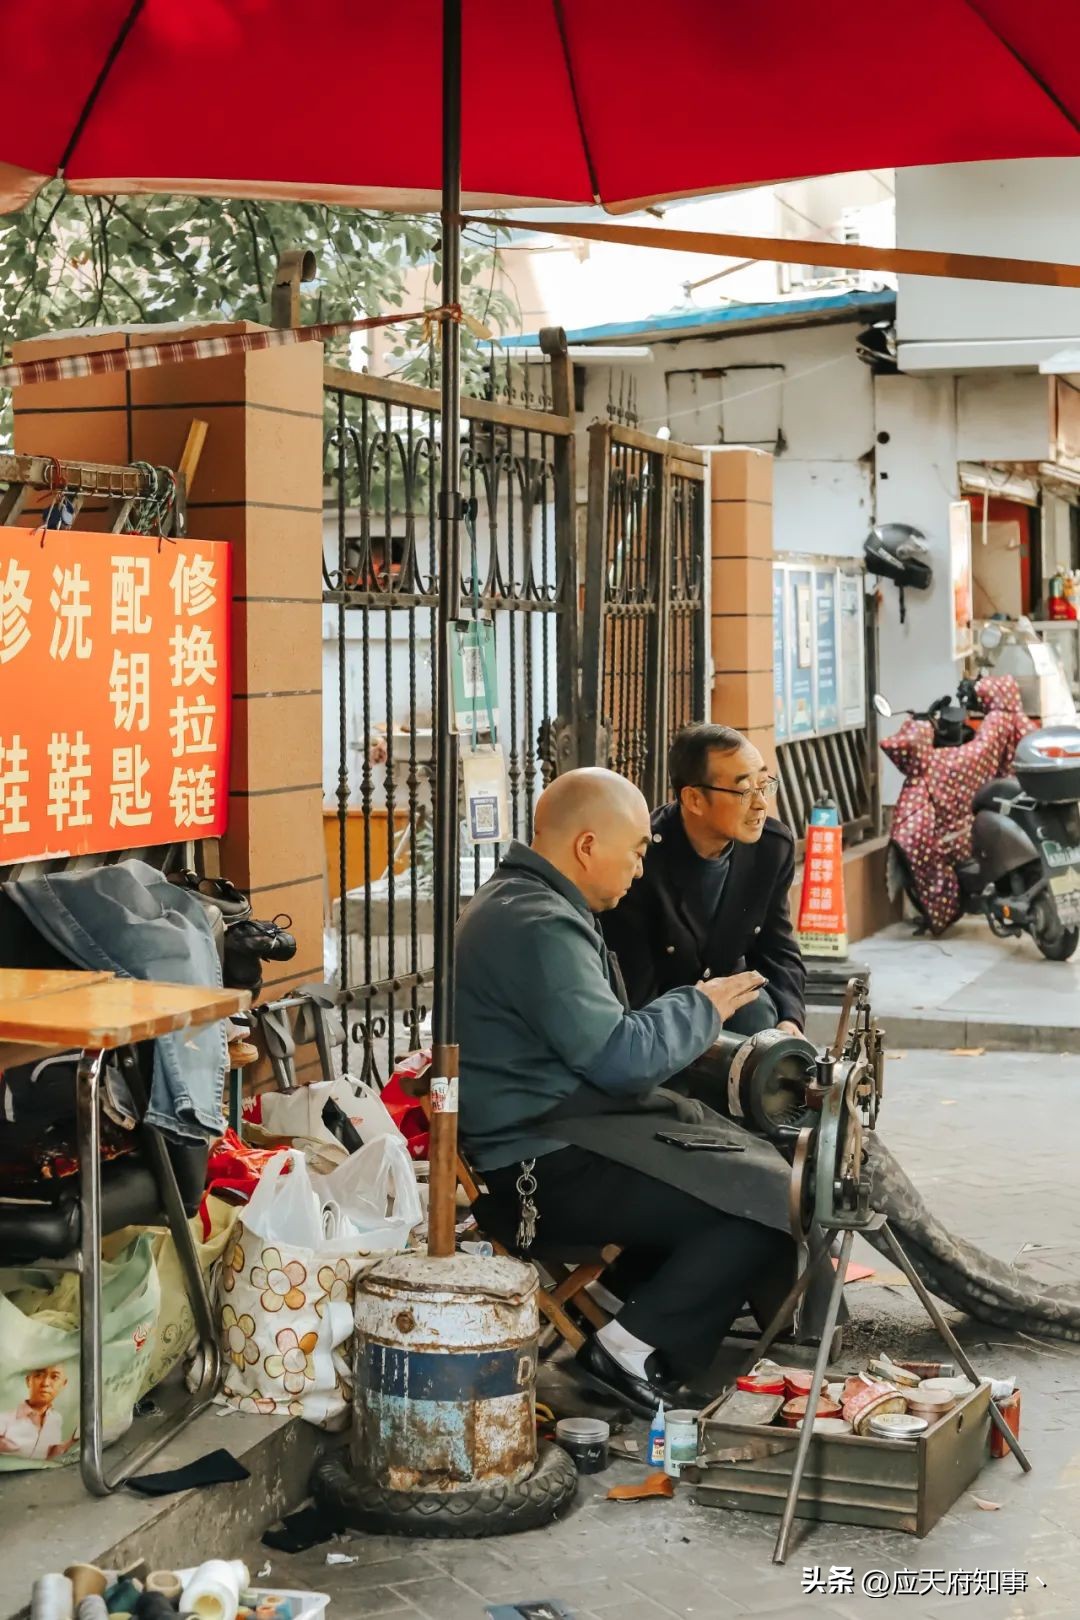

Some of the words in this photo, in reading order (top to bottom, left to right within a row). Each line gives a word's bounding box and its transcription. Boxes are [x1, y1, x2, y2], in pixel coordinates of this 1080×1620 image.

[47, 563, 93, 831] 洗鞋
[109, 555, 152, 828] 配钥匙
[168, 553, 218, 828] 修换拉链
